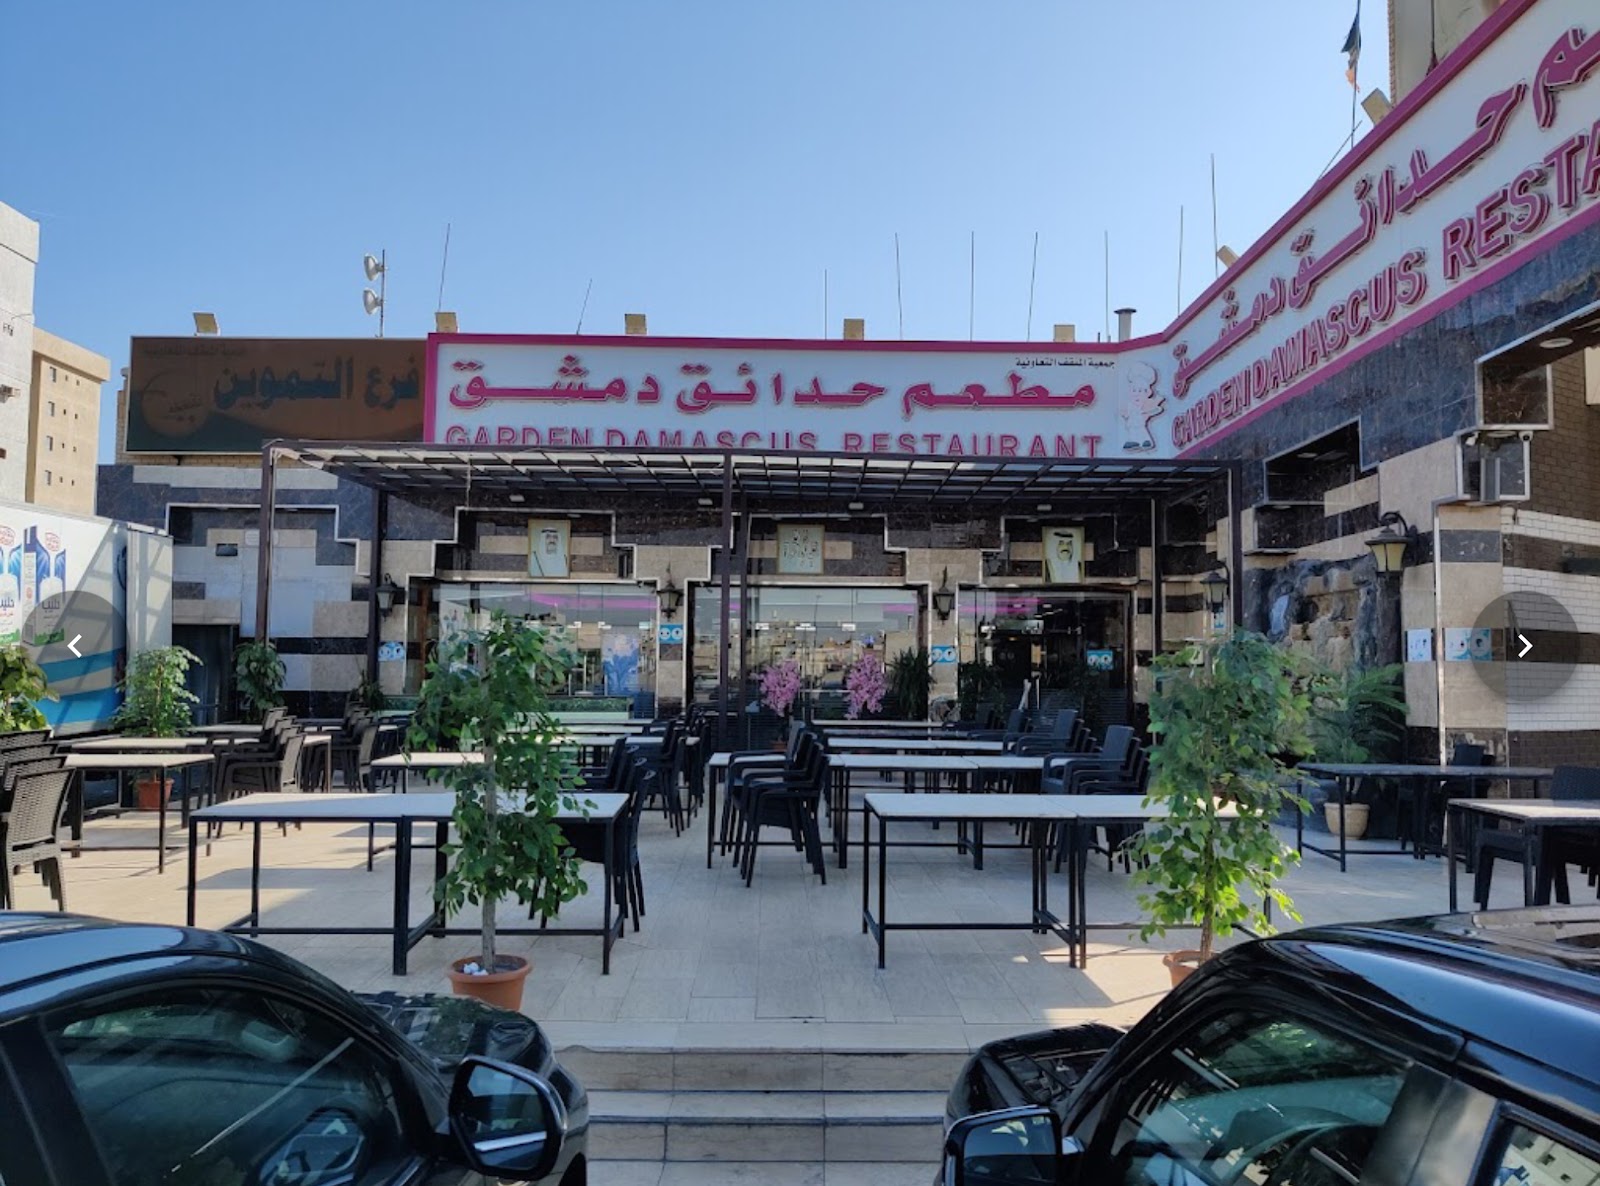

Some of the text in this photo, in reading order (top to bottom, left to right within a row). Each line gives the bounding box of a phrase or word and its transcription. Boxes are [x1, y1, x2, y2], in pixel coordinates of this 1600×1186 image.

[1173, 80, 1528, 398] حدائق دمشق
[1172, 366, 1251, 447] GARDEN
[1253, 248, 1427, 399] DAMASCUS
[213, 355, 355, 410] التموين
[363, 354, 420, 410] فرع
[449, 354, 1097, 421] مطعم حدائق دمشق
[445, 425, 1103, 458] GARDEN DAMASCUS RESTAURANT
